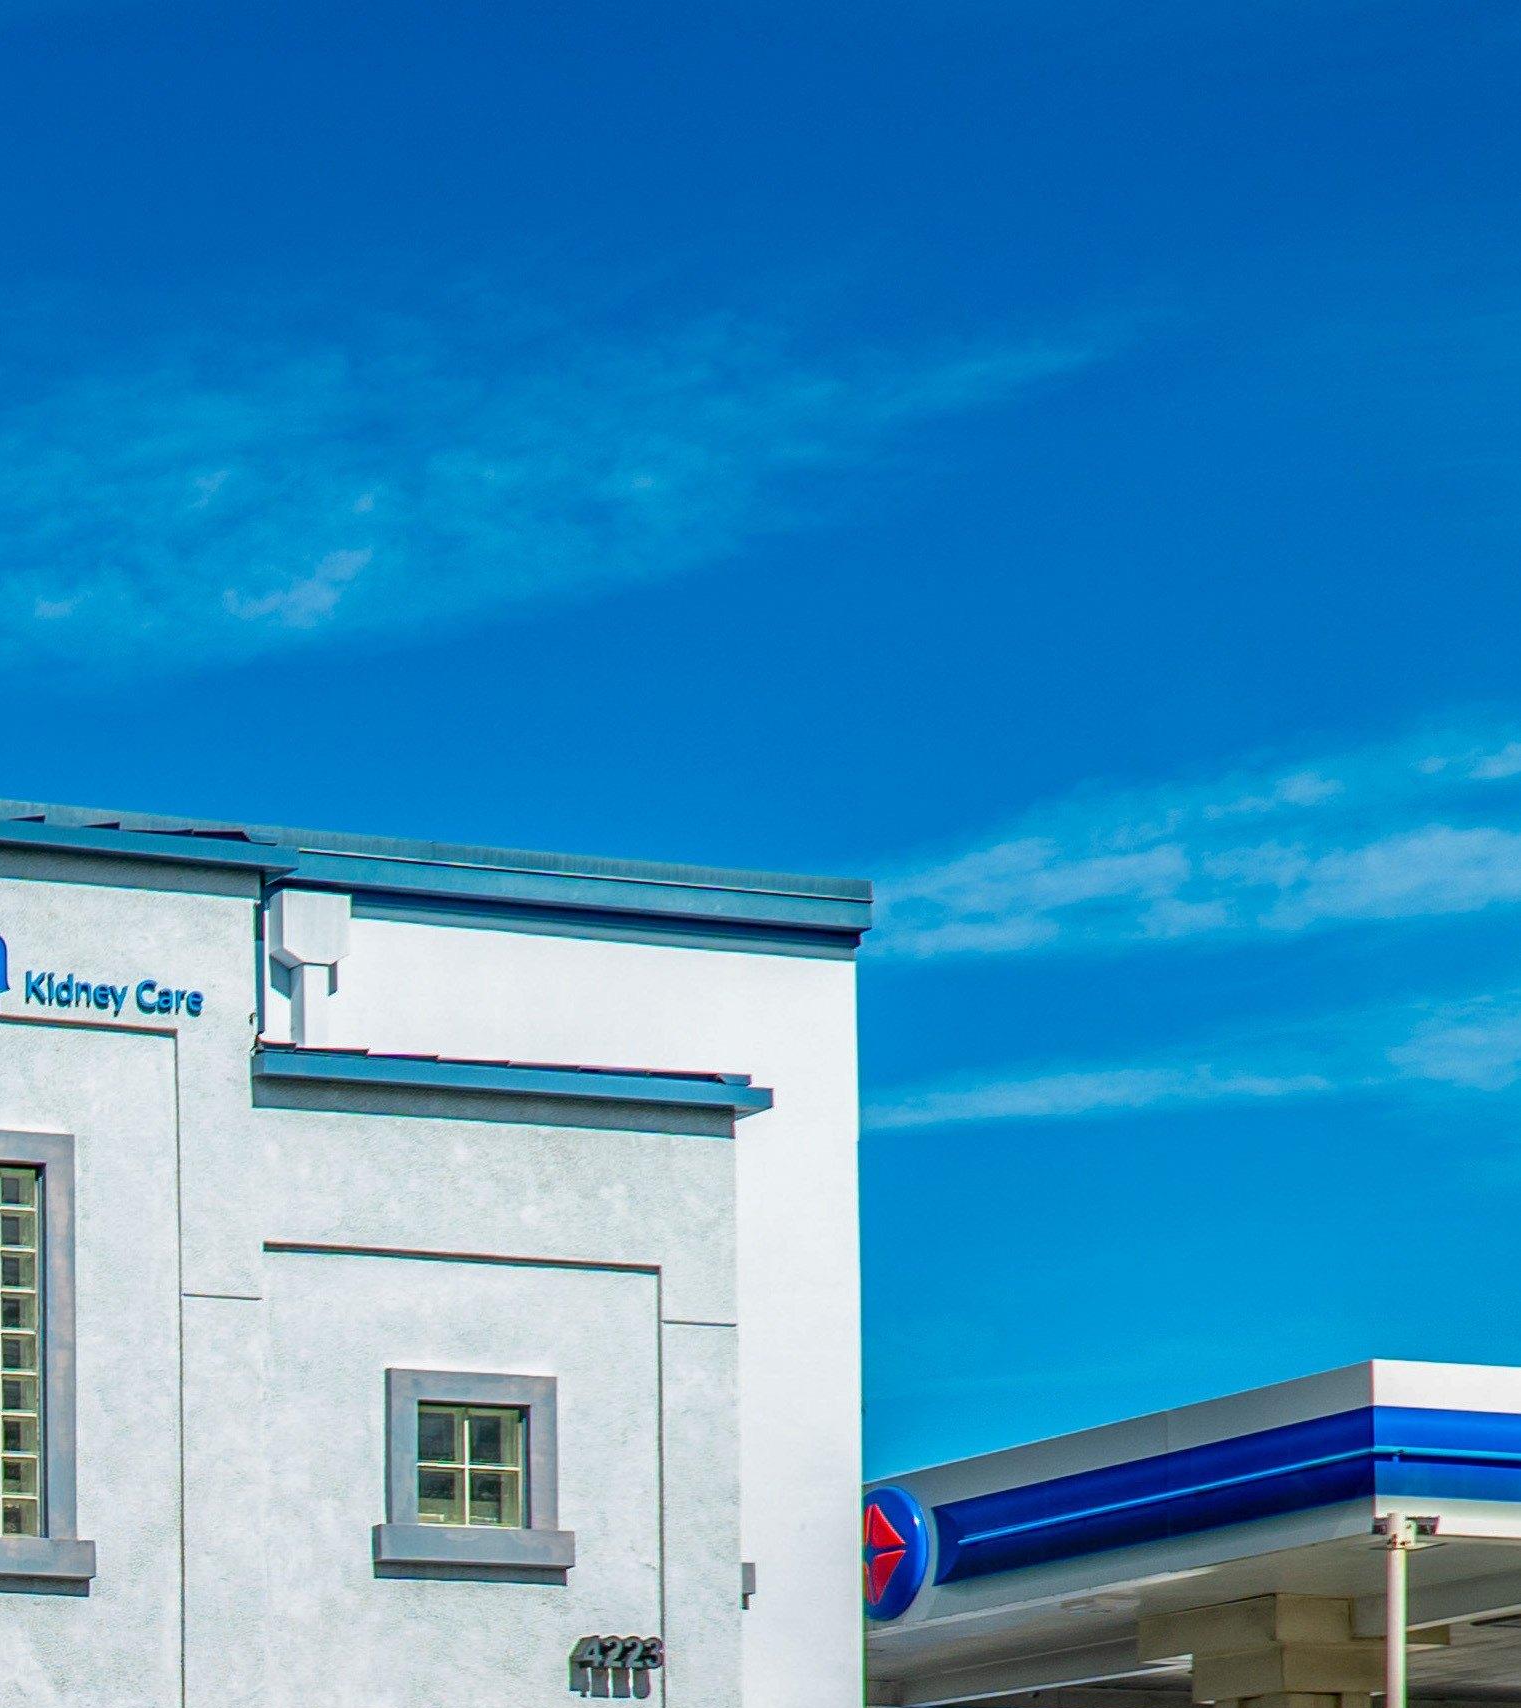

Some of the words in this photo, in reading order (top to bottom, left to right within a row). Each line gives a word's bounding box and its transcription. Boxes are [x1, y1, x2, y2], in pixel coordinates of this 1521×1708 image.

[25, 970, 128, 1018] Kidney
[136, 979, 205, 1018] Care
[573, 1635, 665, 1669] 4223
